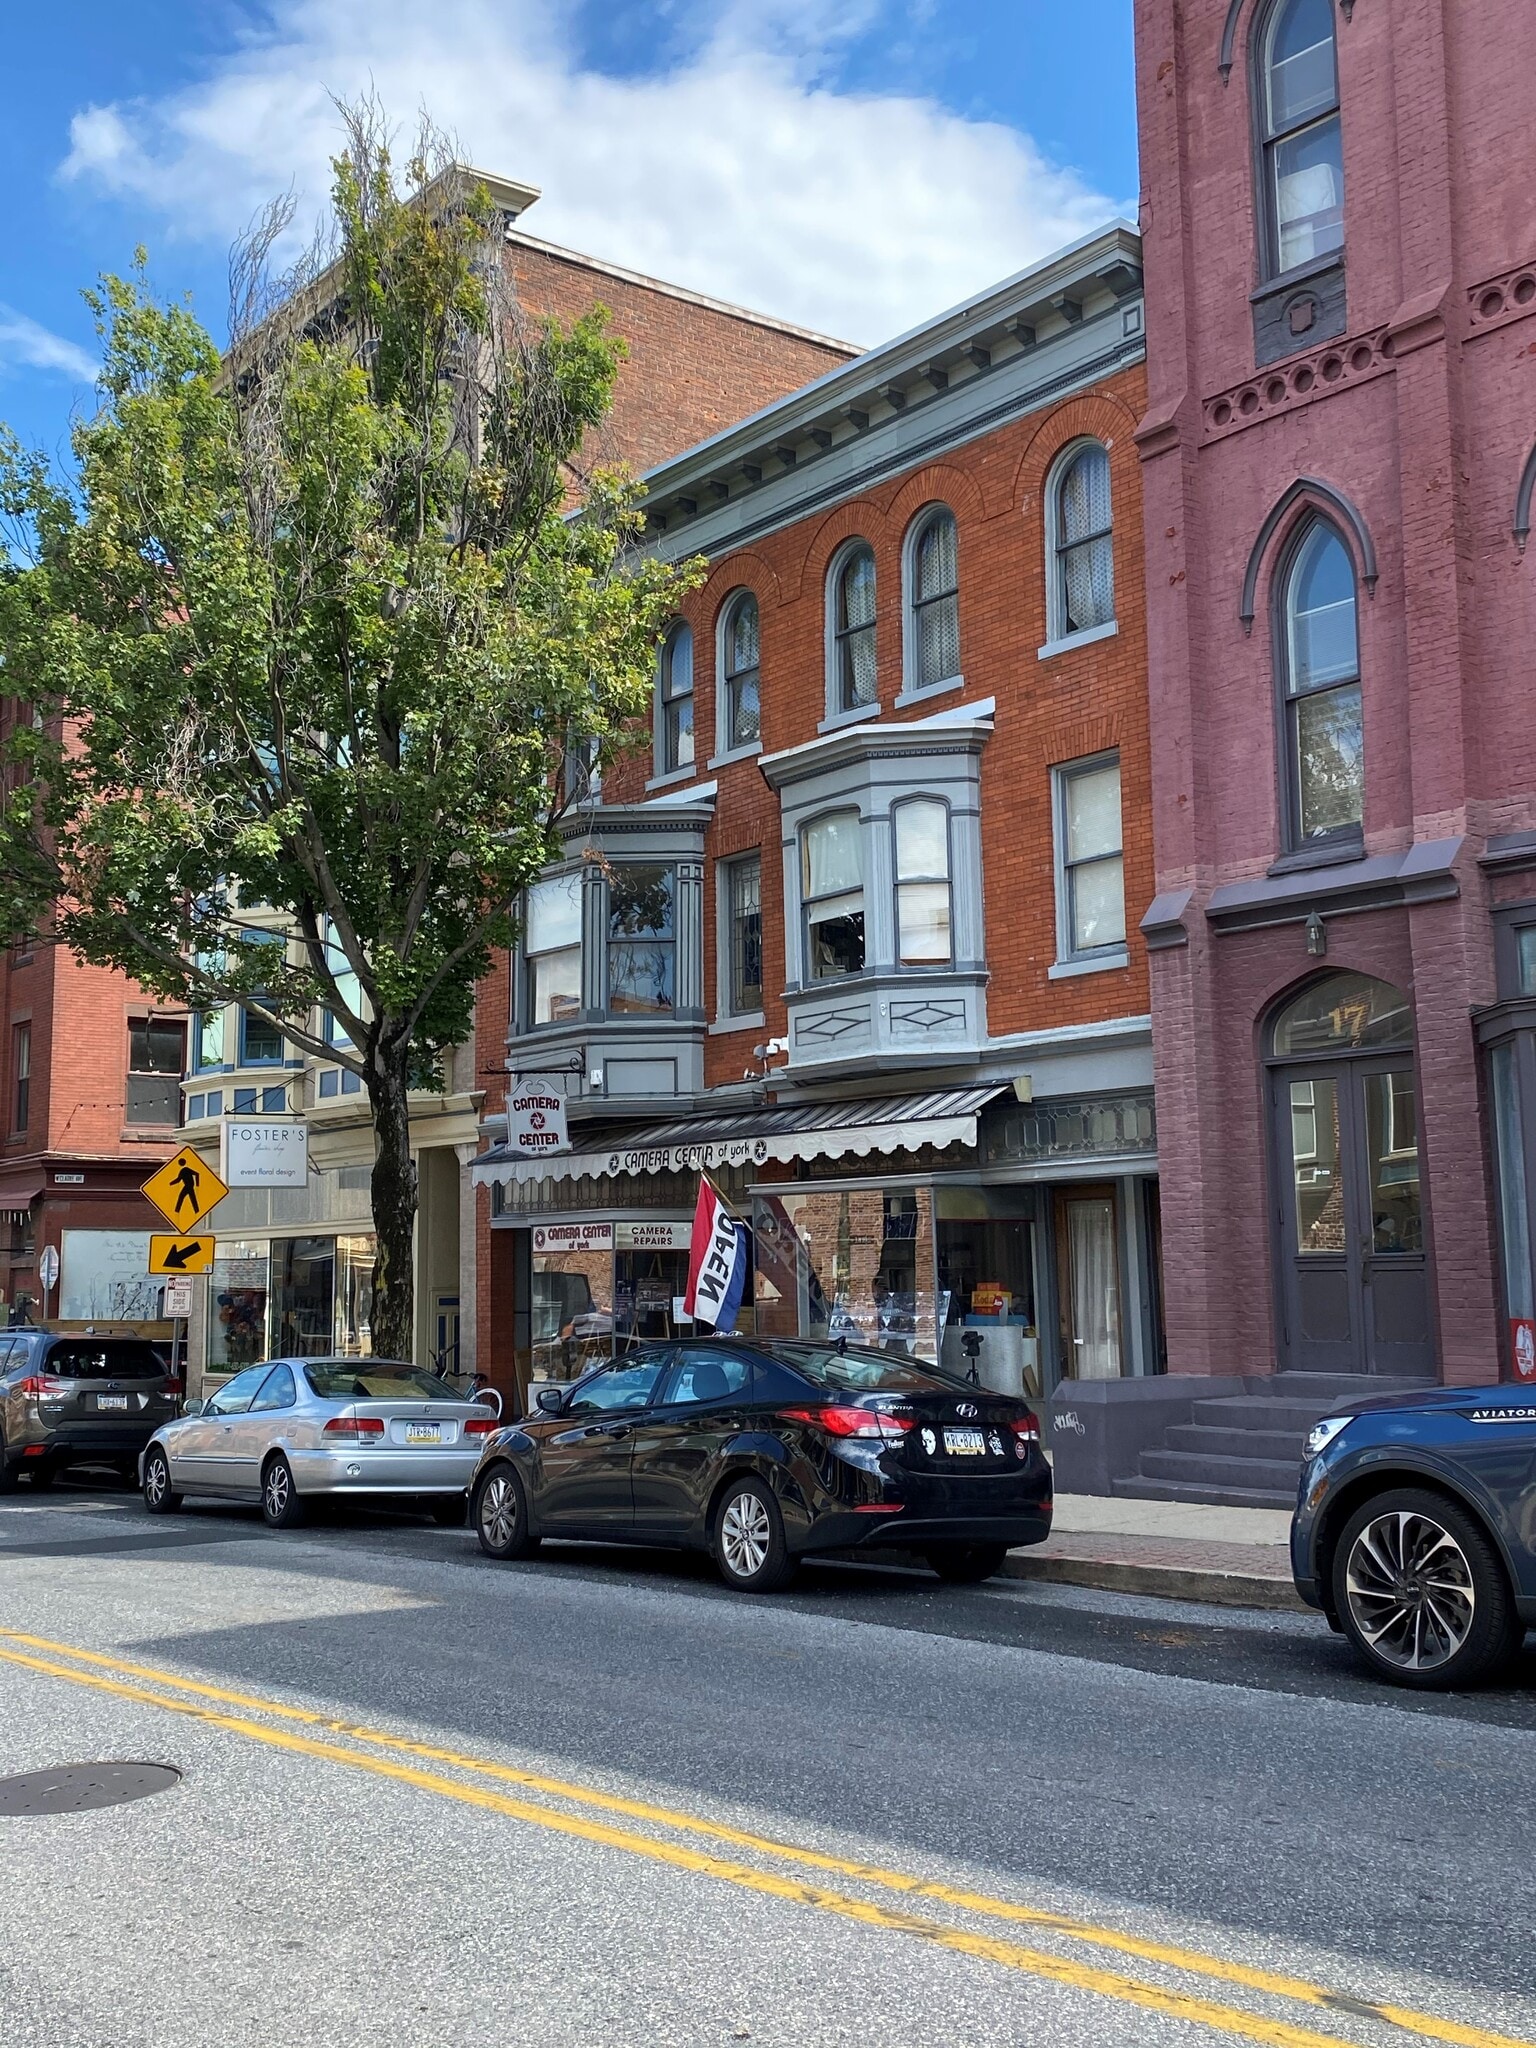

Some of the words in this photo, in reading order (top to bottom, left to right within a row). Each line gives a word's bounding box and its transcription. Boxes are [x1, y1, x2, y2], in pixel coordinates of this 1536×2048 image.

[1328, 1004, 1367, 1037] 17
[513, 1096, 560, 1111] CAMERA
[232, 1129, 305, 1141] FOSTER'S
[519, 1132, 559, 1146] CENTER
[625, 1150, 669, 1169] CAMERA
[718, 1144, 728, 1157] of
[731, 1142, 749, 1160] york
[258, 1167, 275, 1176] floral
[275, 1168, 296, 1177] design
[547, 1226, 581, 1240] CAMERA
[582, 1224, 612, 1239] CENTER
[631, 1227, 673, 1235] CAMERA
[568, 1240, 575, 1249] of
[577, 1239, 590, 1251] york
[633, 1237, 673, 1245] REPAIRS
[1472, 1408, 1536, 1419] AVIATOR
